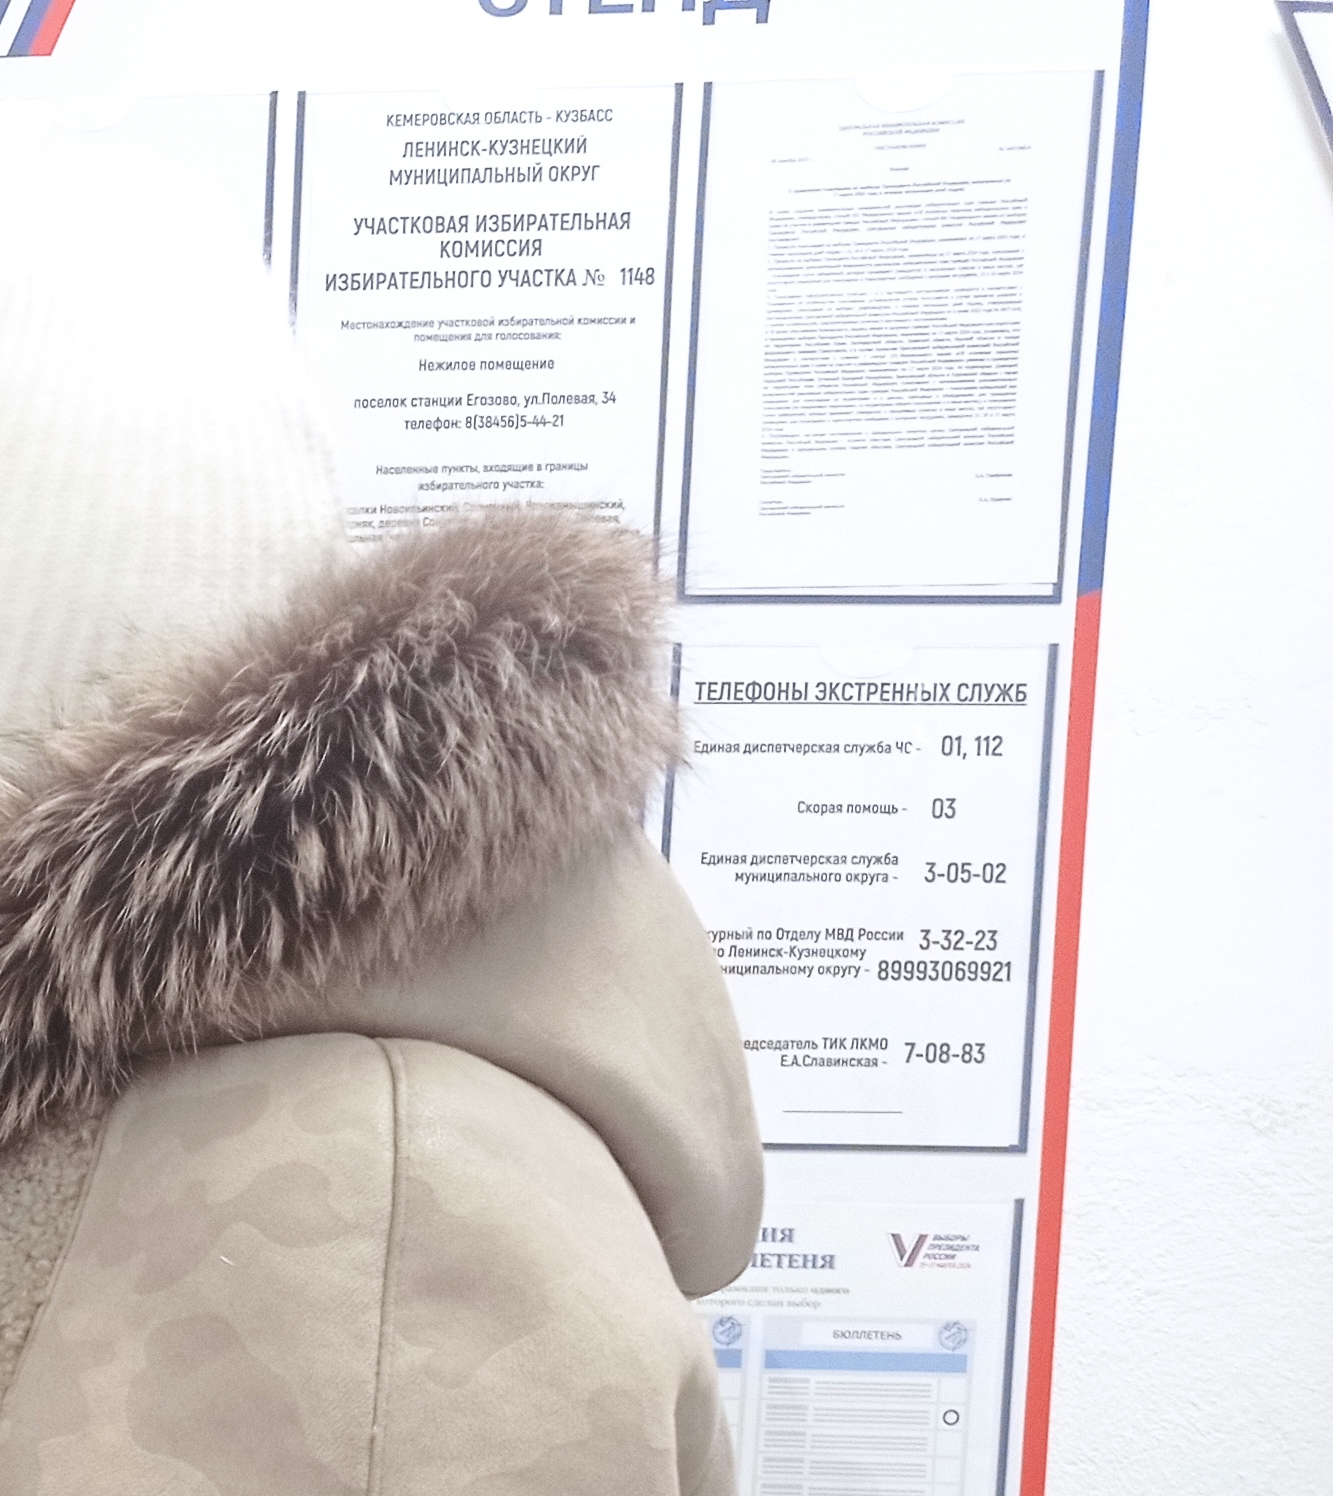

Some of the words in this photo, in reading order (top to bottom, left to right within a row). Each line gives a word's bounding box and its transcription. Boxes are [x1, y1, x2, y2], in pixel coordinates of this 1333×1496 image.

[386, 112, 480, 127] КЕМЕРОВСКАЯ
[484, 110, 543, 125] ОБЛАСТЬ
[555, 108, 613, 123] КУЗБАСС
[402, 135, 587, 158] ЛЕНИНСК-КУЗНЕЦКИЙ
[389, 163, 543, 187] МУНИЦИПАЛЬНЫЙ
[548, 164, 600, 183] ОКРУГ
[353, 214, 469, 236] УЧАСТКОВАЯ
[475, 211, 631, 233] ИЗБИРАТЕЛЬНАЯ
[439, 238, 542, 259] КОМИССИЯ
[325, 269, 492, 292] ИЗБИРАТЕЛЬНОГО
[497, 268, 577, 288] УЧАСТКА
[581, 268, 605, 287] №
[620, 267, 655, 286] 1148
[340, 320, 435, 330] Местонахождение
[437, 318, 495, 330] участковой
[497, 317, 575, 329] избирательной
[577, 317, 627, 326] комиссии
[629, 317, 636, 325] и
[413, 333, 472, 342] помещения
[473, 332, 493, 343] для
[495, 331, 562, 341] голосования:
[418, 359, 476, 372] Нежилое
[479, 359, 555, 372] помещение
[354, 397, 407, 409] поселок
[410, 396, 463, 408] станции
[466, 393, 520, 407] Егозово,
[523, 392, 598, 408] ул.Полевая,
[601, 391, 617, 404] 34
[404, 416, 462, 432] телефон:
[465, 414, 564, 431] 8(38456)5-44-21
[375, 465, 439, 475] Населенные
[441, 465, 480, 476] пункты,
[483, 463, 534, 473] входящие
[536, 463, 543, 472] в
[544, 463, 589, 474] границы
[418, 480, 500, 493] избирательного
[502, 480, 544, 492] участка:
[695, 681, 809, 703] ТЕЛЕФОНЫ
[814, 681, 951, 703] ЭКСТРЕННЫХ
[956, 682, 1027, 703] СЛУЖБ
[694, 740, 740, 755] Единая
[742, 743, 840, 756] диспетчерская
[843, 740, 892, 757] служба
[895, 740, 913, 755] ЧС
[941, 735, 967, 760] 01,
[974, 735, 1003, 757] 112
[797, 800, 843, 817] Скорая
[846, 803, 899, 816] помощь
[931, 797, 957, 819] 03
[700, 851, 747, 867] Единая
[749, 854, 847, 868] диспетчерская
[850, 852, 899, 869] служба
[734, 872, 842, 885] муниципального
[845, 872, 889, 886] округа
[924, 862, 1007, 884] 3-05-02
[707, 927, 753, 942] урный
[756, 930, 773, 941] по
[775, 927, 822, 944] Отделу
[824, 927, 855, 943] МВД
[857, 927, 904, 941] России
[919, 929, 998, 951] 3-32-23
[717, 946, 725, 958] о
[727, 944, 867, 962] Ленинск-Кузнецкому
[720, 964, 815, 978] ниципальному
[817, 965, 862, 979] округу
[877, 959, 1011, 982] 89993069921
[743, 1039, 819, 1052] едседатель
[822, 1036, 847, 1050] ТИК
[849, 1037, 889, 1051] ЛКМО
[904, 1042, 986, 1064] 7-08-83
[780, 1054, 879, 1068] Е.А.Славинская
[751, 1252, 835, 1269] ЕТЕНЯ
[832, 1329, 902, 1341] БЮЛЛЕТЕНЬ
